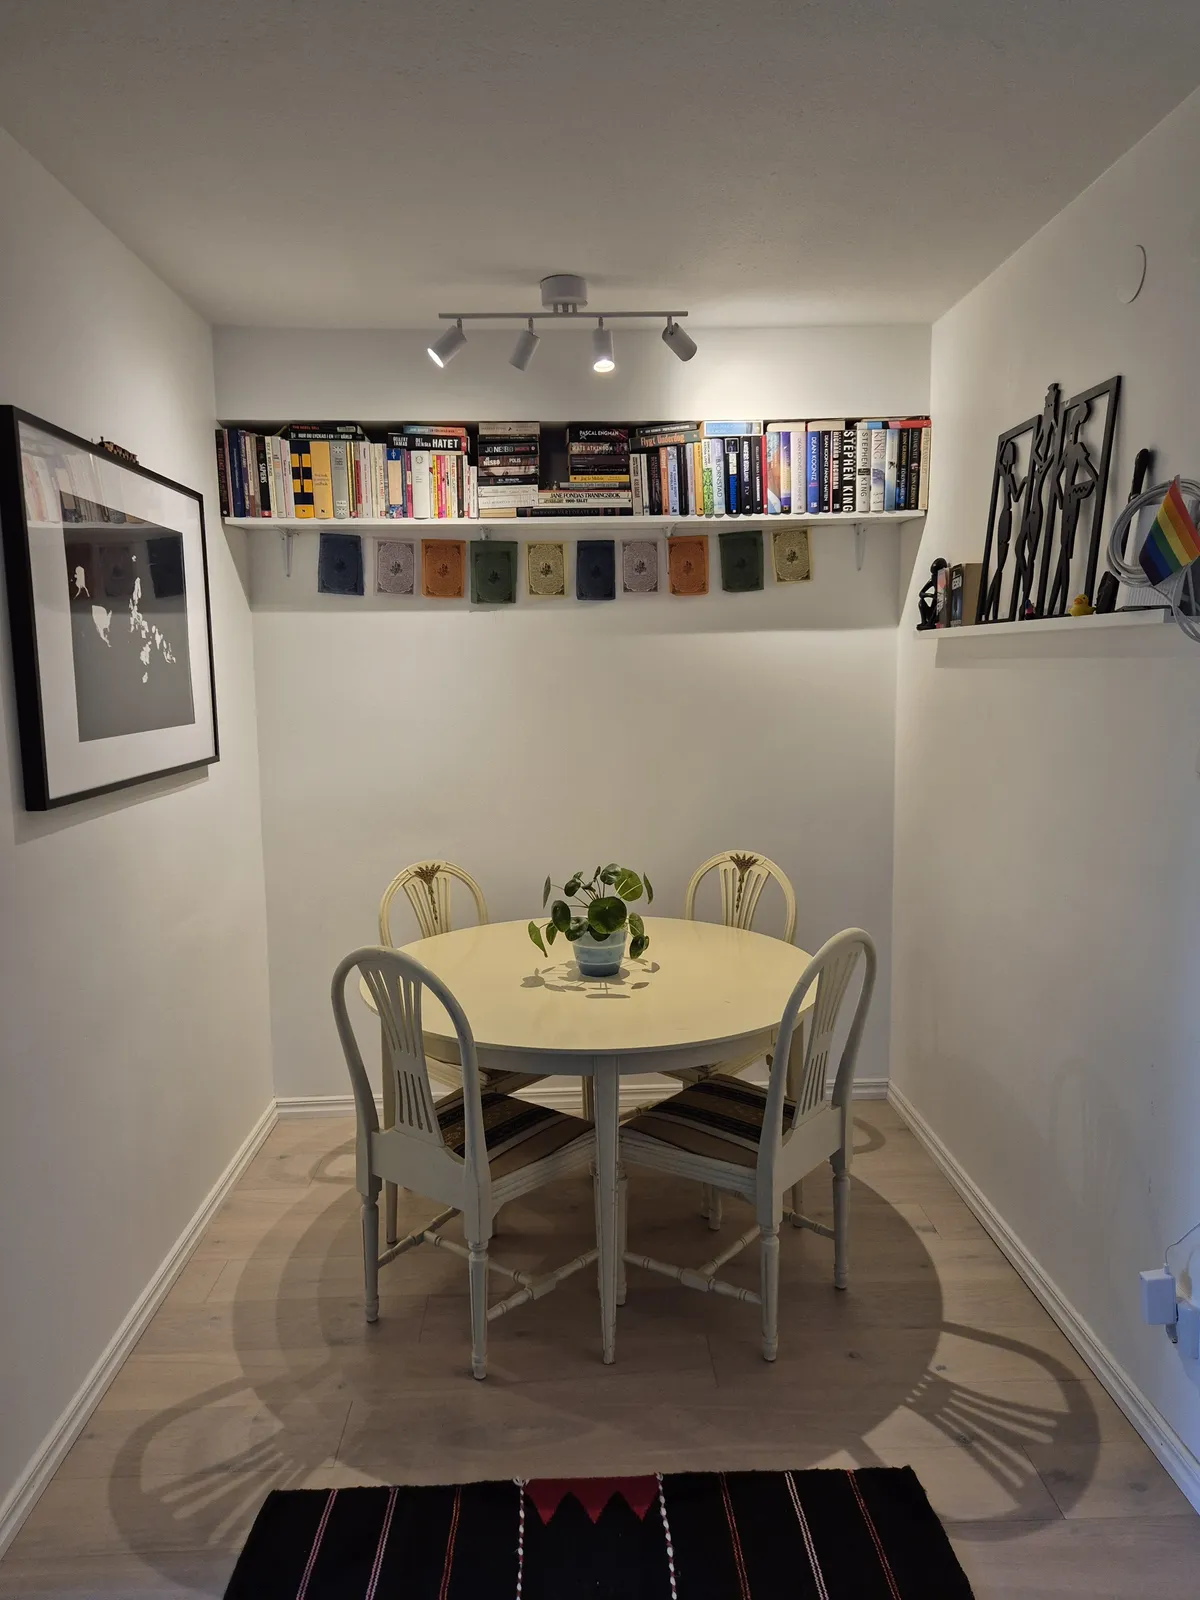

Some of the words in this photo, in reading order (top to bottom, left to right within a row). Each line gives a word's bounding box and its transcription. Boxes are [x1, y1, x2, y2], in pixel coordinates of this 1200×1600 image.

[432, 439, 458, 448] HATET
[843, 431, 854, 481] STEPHEN
[259, 463, 267, 483] SAPIENS
[842, 486, 853, 511] KING
